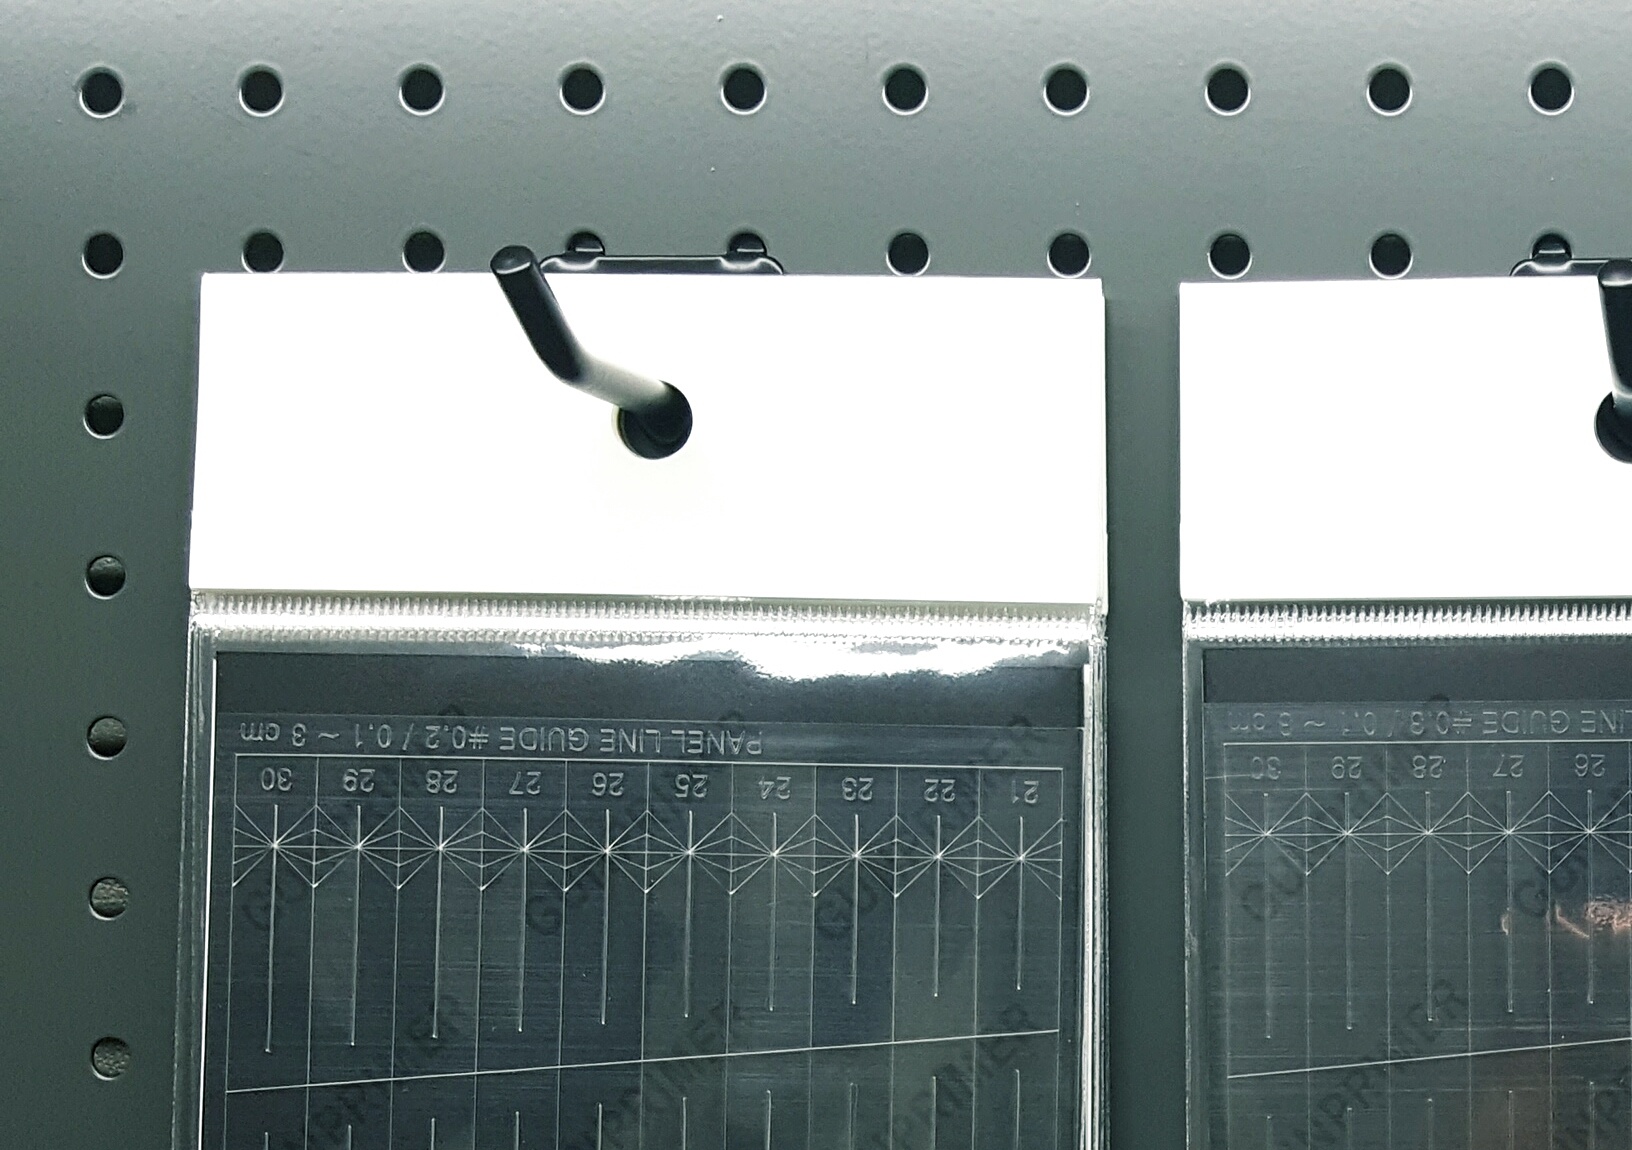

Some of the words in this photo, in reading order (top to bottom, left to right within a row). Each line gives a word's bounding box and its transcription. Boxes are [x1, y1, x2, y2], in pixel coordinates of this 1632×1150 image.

[240, 722, 280, 741] cm
[1482, 710, 1570, 734] GUIDE
[354, 724, 392, 748] 0.1
[426, 724, 489, 750] #0.2
[500, 726, 590, 752] GUIDE
[600, 728, 660, 753] LINE
[671, 730, 762, 755] PANEL
[1332, 756, 1362, 779] 29
[1413, 755, 1443, 778] 28
[1493, 755, 1523, 777] 27
[1575, 754, 1605, 776] 26
[262, 768, 292, 791] 30
[343, 769, 375, 792] 29
[427, 770, 458, 793] 28
[509, 772, 540, 794] 27
[592, 773, 623, 796] 26
[675, 774, 707, 797] 25
[759, 777, 790, 799] 24
[842, 778, 873, 800] 23
[925, 779, 955, 802] 22
